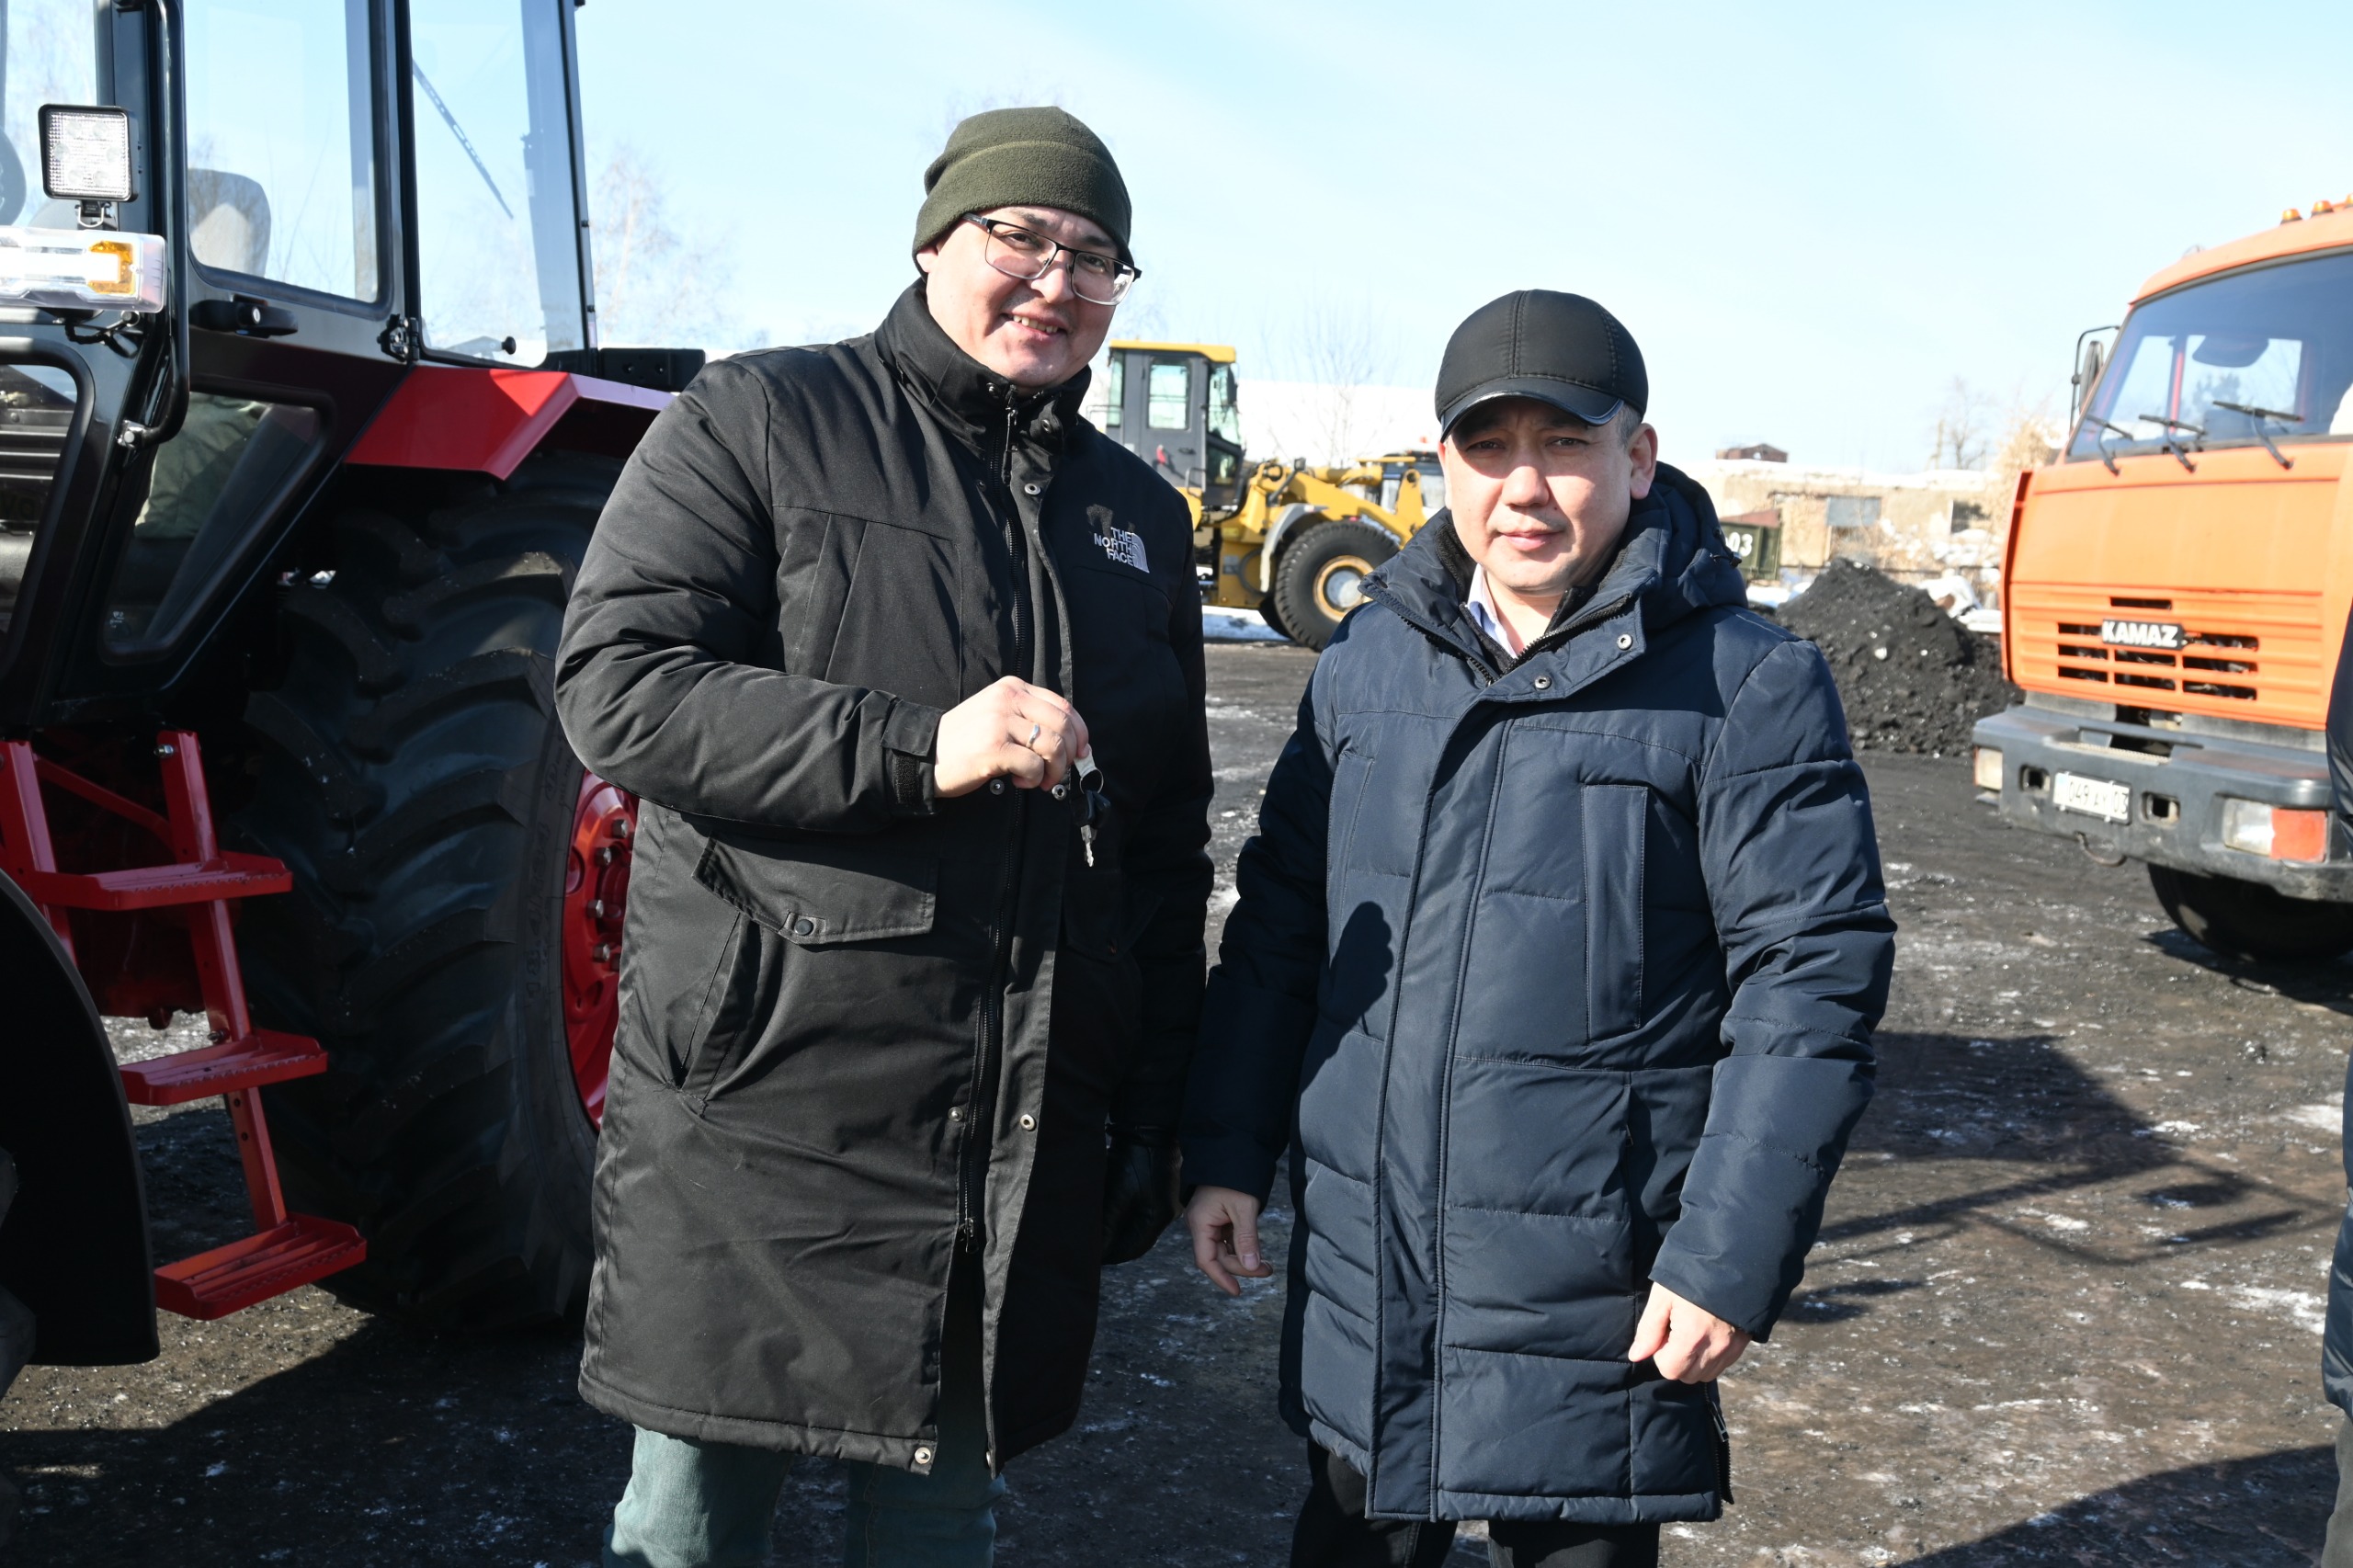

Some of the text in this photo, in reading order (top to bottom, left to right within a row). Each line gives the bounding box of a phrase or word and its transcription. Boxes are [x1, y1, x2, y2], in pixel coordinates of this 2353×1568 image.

[1094, 533, 1132, 554] NORTH
[1110, 527, 1131, 543] THE
[1725, 532, 1753, 557] 03
[1107, 548, 1133, 566] FACE
[2102, 620, 2177, 648] KAMAZ
